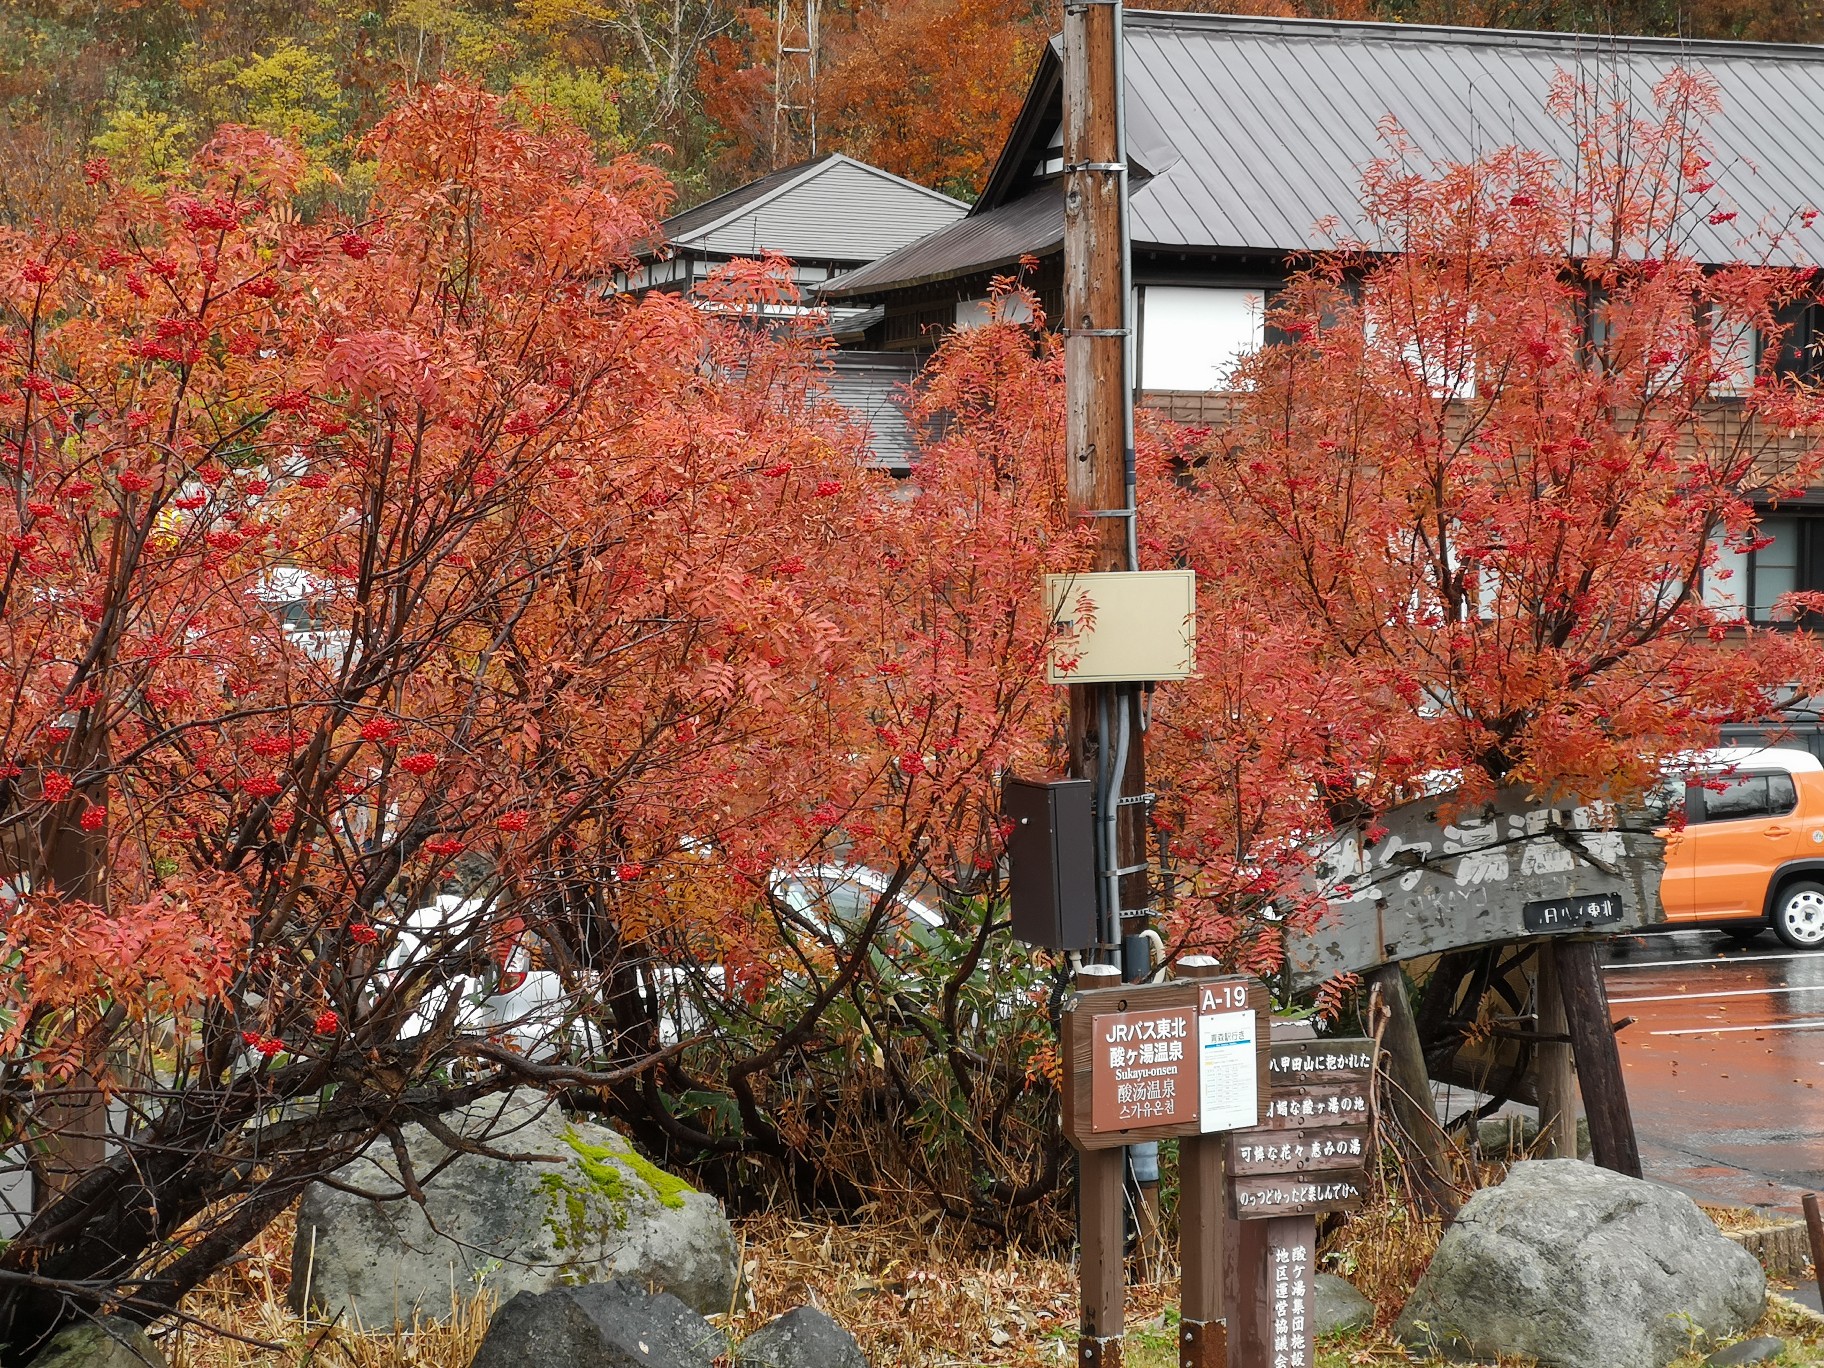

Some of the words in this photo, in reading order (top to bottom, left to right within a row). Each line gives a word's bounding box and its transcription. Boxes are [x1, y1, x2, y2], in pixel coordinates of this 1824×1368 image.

[1202, 986, 1246, 1011] A-19
[1106, 1017, 1187, 1043] JRバス東北
[1269, 1053, 1370, 1072] 八甲田山に抱かれた
[1115, 1065, 1178, 1082] Sukayu-onsen
[1117, 1078, 1176, 1103] 酸汤温泉
[1119, 1099, 1175, 1119] 스가유온천
[1311, 1138, 1361, 1158] 恵みの湯
